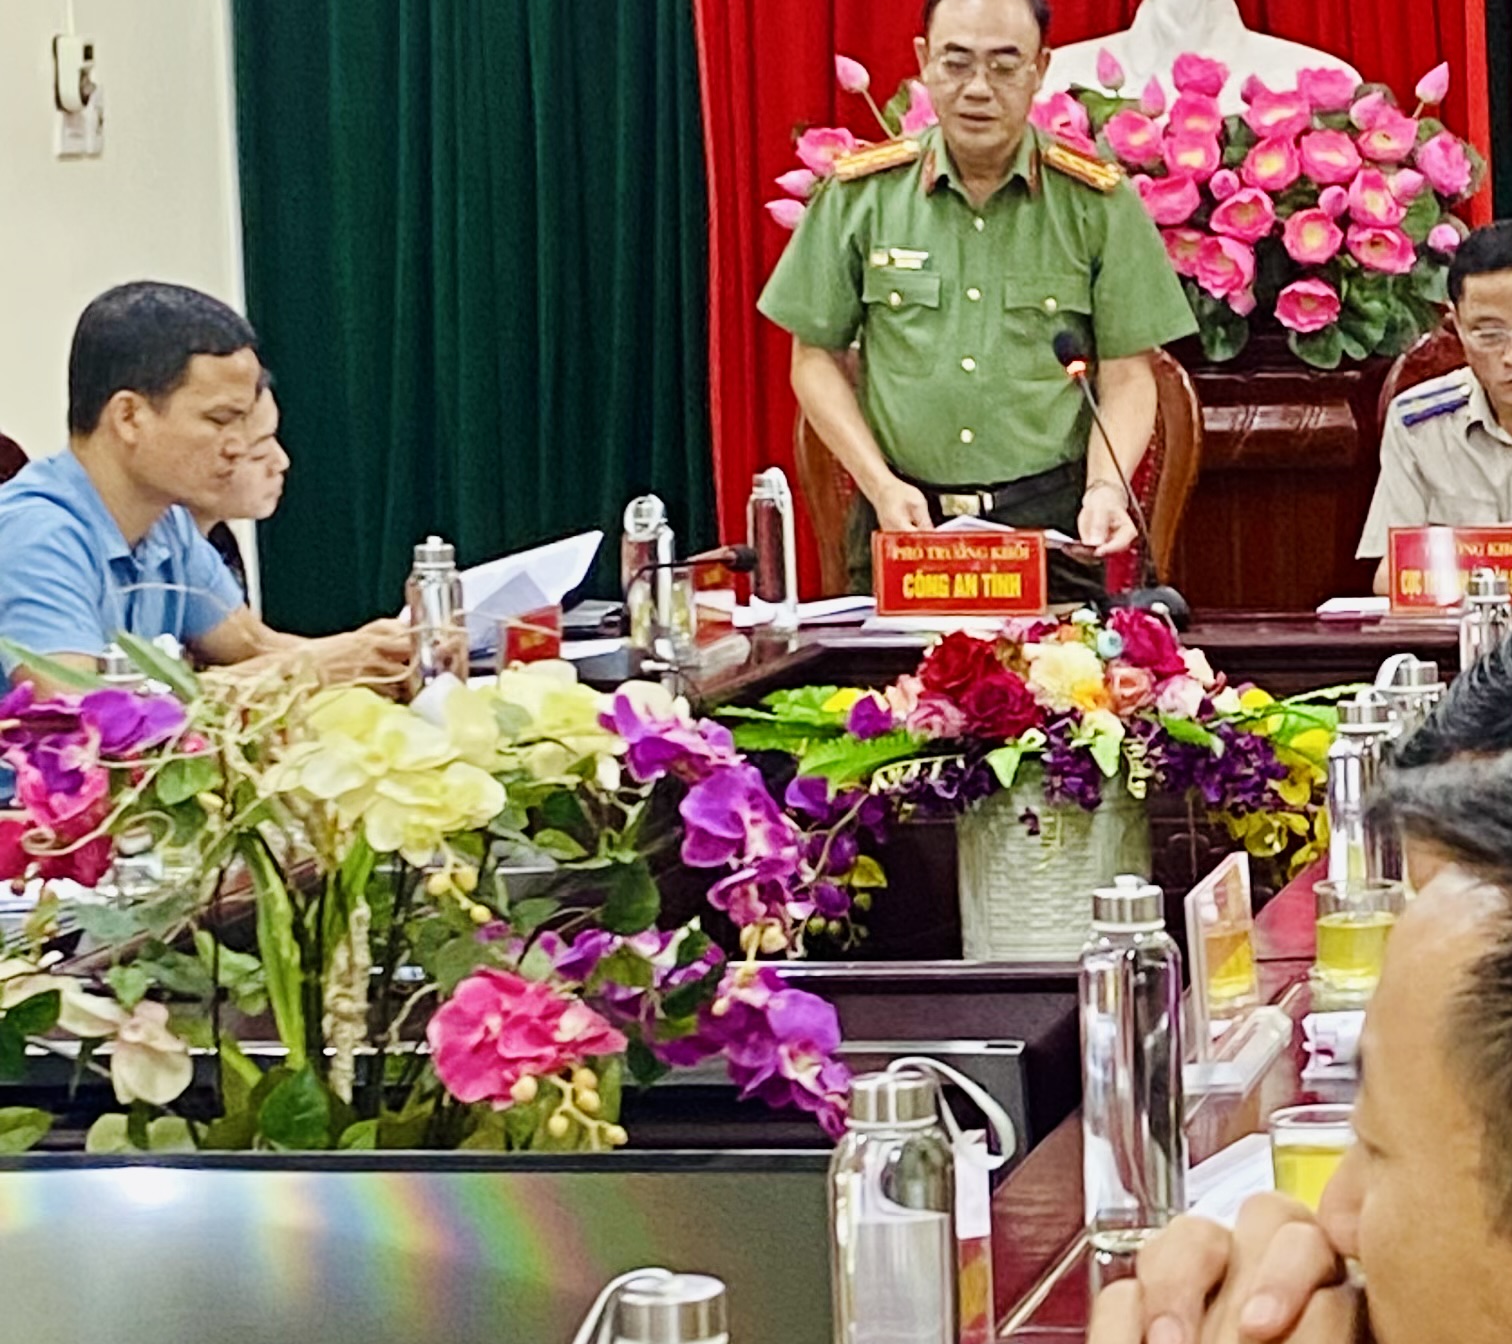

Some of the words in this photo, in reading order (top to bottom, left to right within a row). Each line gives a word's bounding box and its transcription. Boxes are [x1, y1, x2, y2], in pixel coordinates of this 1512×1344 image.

[902, 570, 950, 599] CÔNG
[953, 572, 978, 598] AN
[981, 564, 1021, 598] TỈNH
